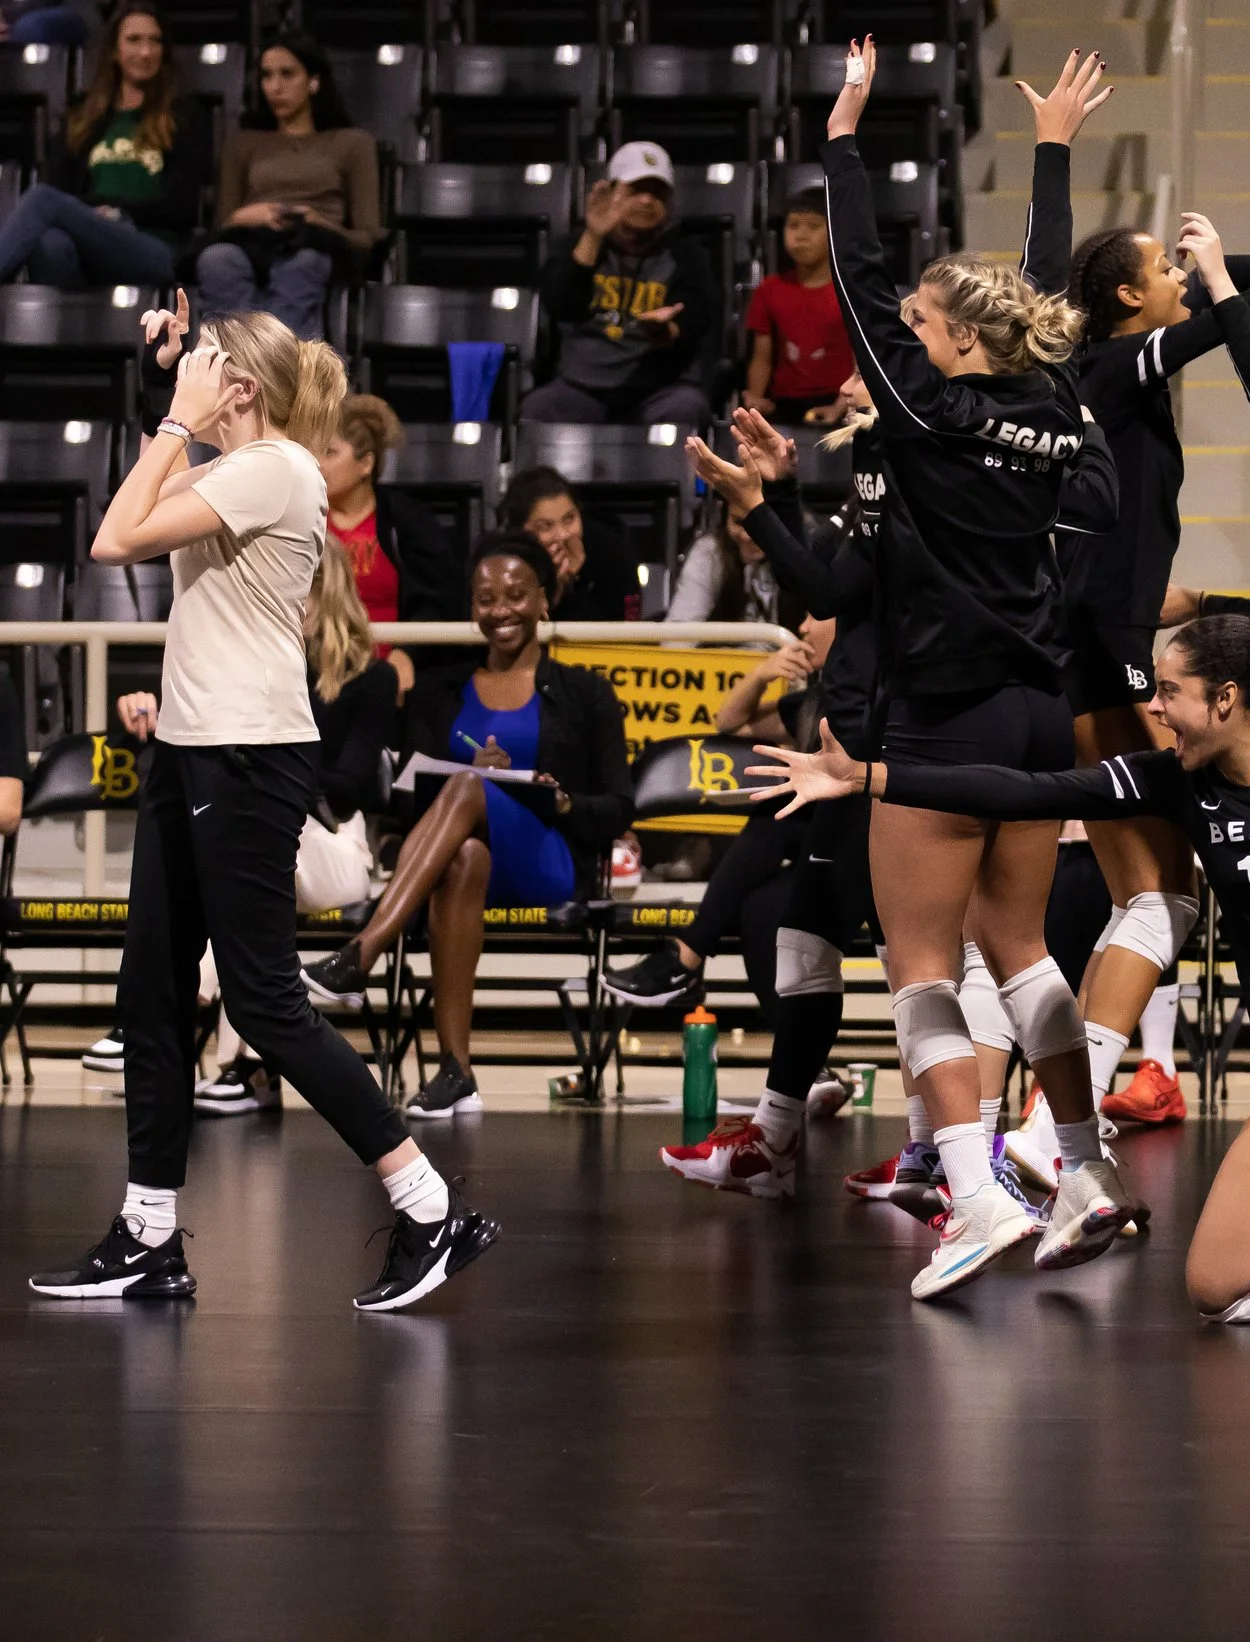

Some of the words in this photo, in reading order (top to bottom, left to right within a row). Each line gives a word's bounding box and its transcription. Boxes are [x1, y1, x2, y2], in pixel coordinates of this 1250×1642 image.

[974, 418, 1082, 460] LEGACY
[985, 451, 1003, 468] 89
[1010, 456, 1027, 472] 93
[1034, 458, 1051, 473] 98
[1124, 664, 1148, 690] LB
[90, 735, 140, 799] LB
[21, 902, 54, 920] LONG
[57, 902, 98, 920] BEACH
[510, 906, 548, 925] STATE
[632, 908, 667, 926] LONG
